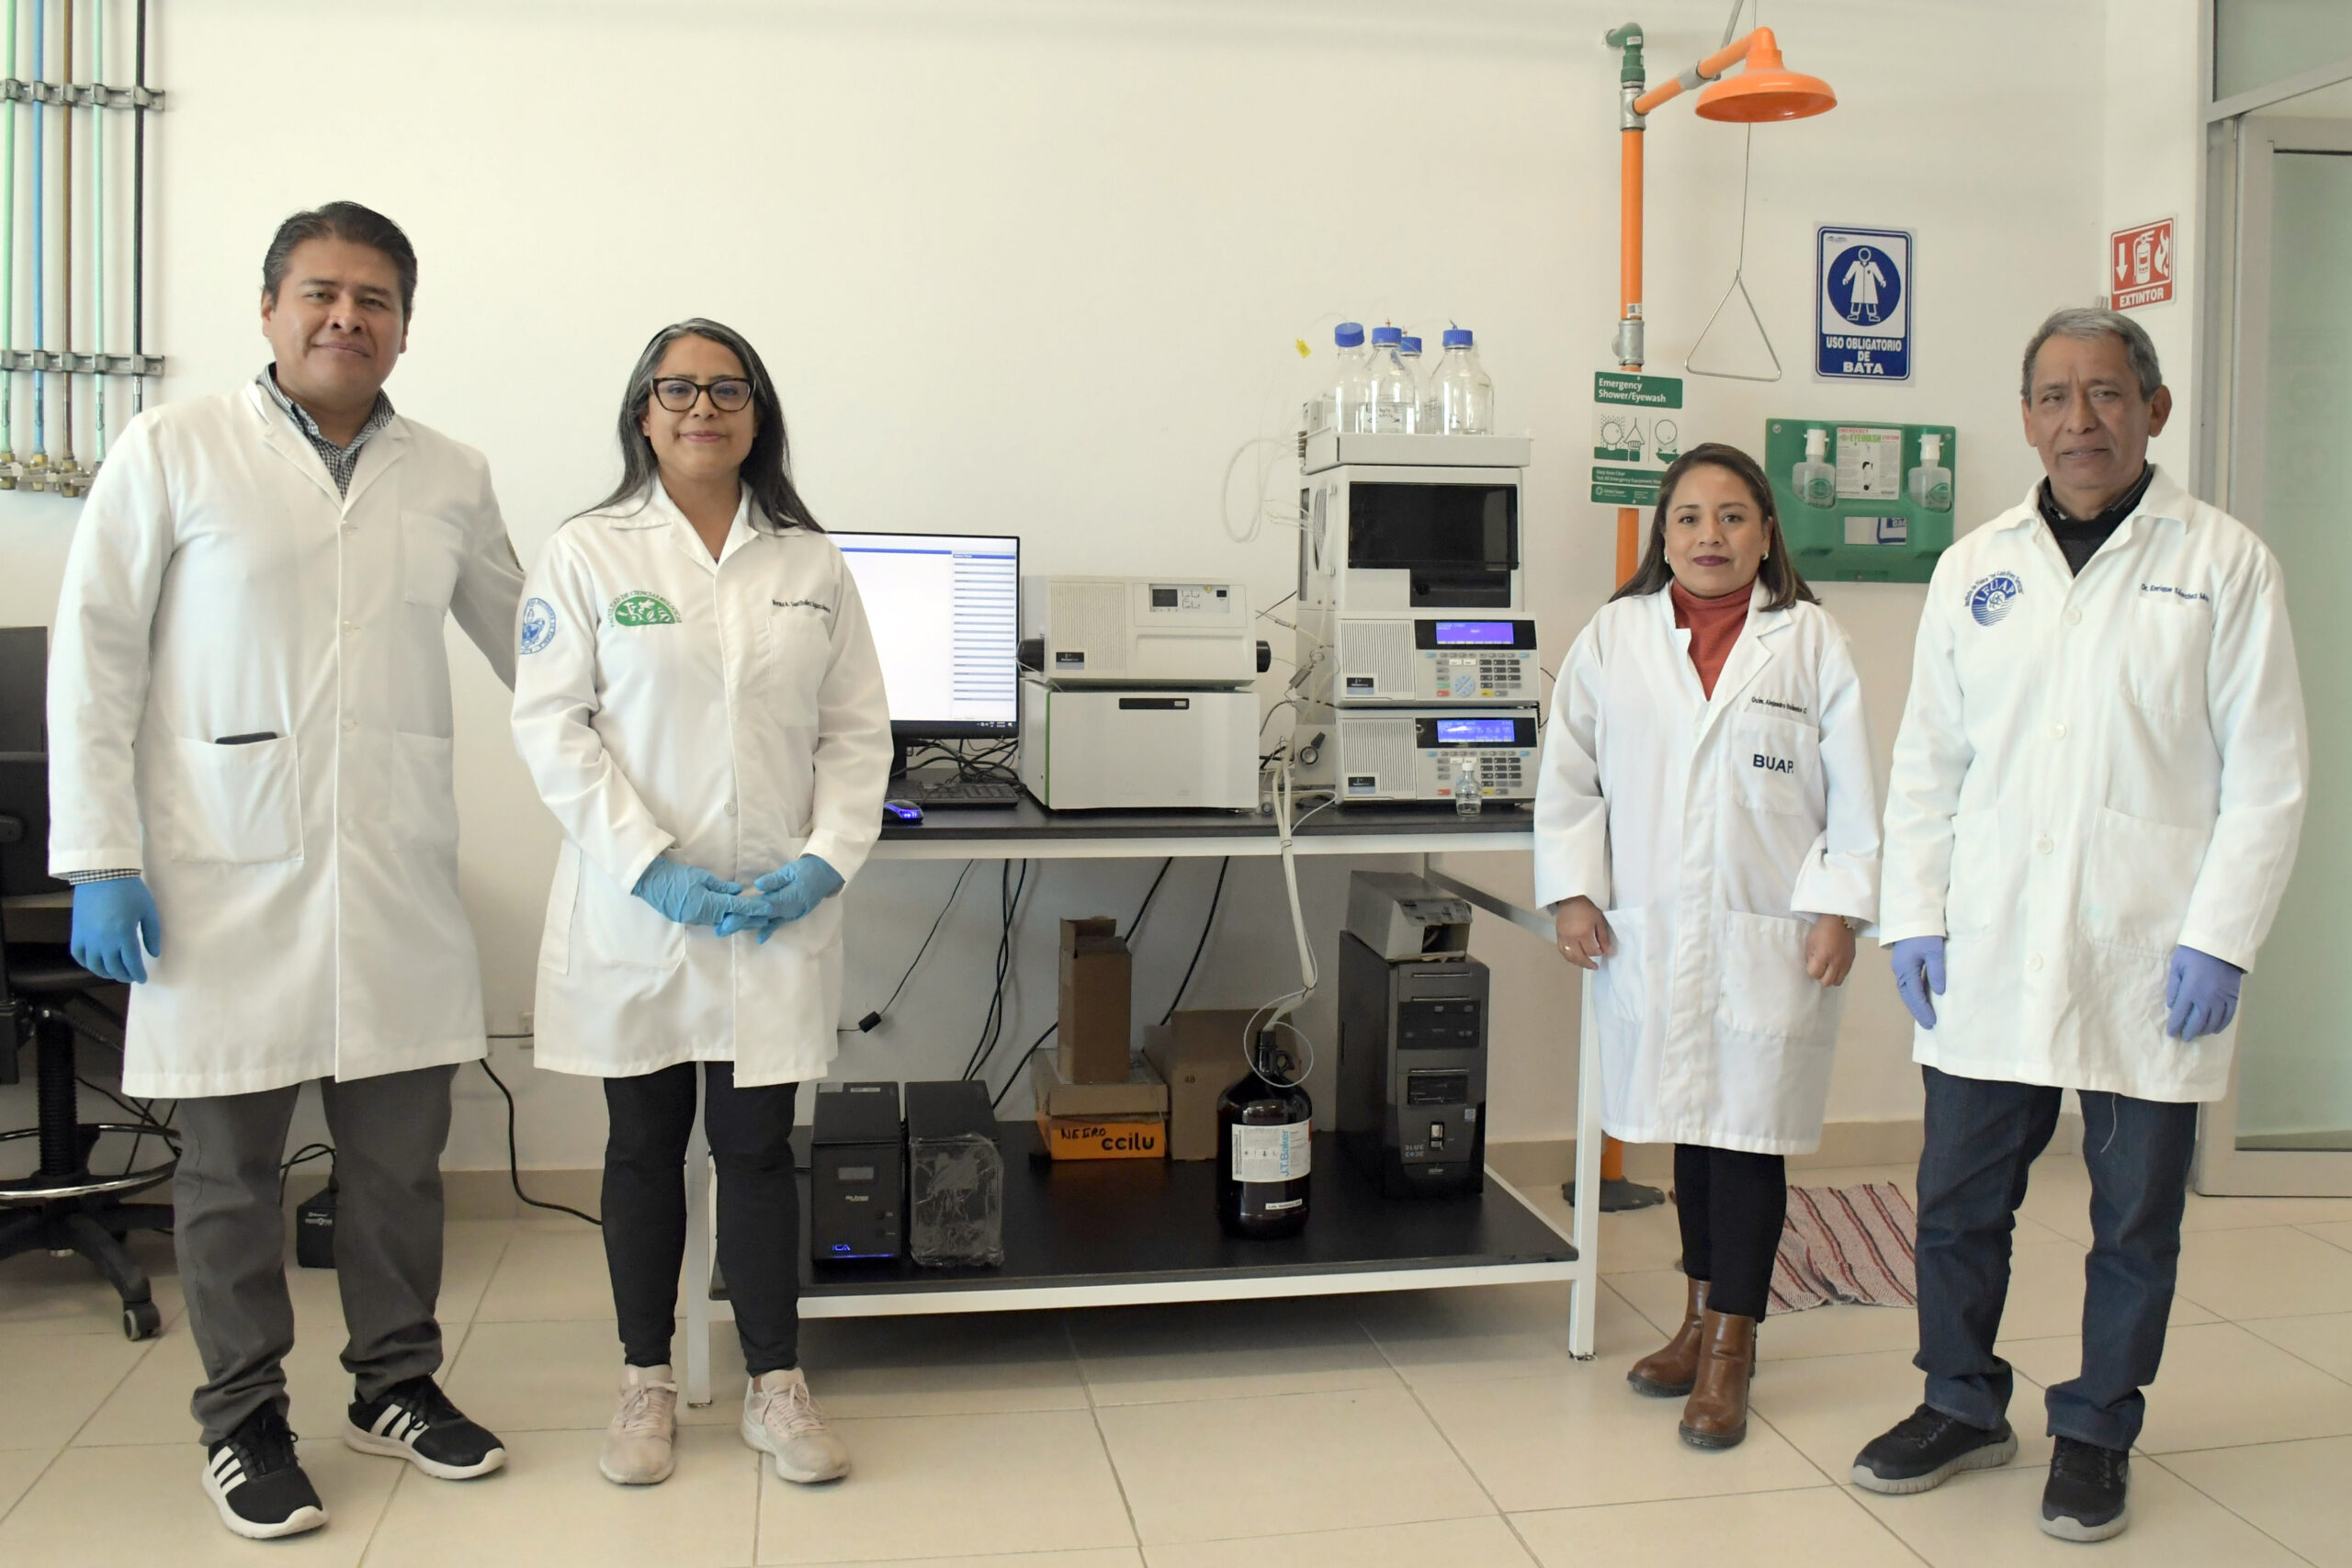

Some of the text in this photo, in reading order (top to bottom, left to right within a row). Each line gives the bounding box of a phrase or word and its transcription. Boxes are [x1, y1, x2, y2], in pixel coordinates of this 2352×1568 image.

[2120, 288, 2165, 308] EXTINTOR
[1826, 336, 1902, 352] USO OBLIGATORIO
[1858, 351, 1871, 362] DE
[1843, 362, 1884, 374] BATA
[1599, 378, 1643, 392] Emergency
[1599, 389, 1667, 403] Shower/Eyewash
[1975, 579, 2015, 602] IFUAP
[1102, 1132, 1155, 1151] ccilu
